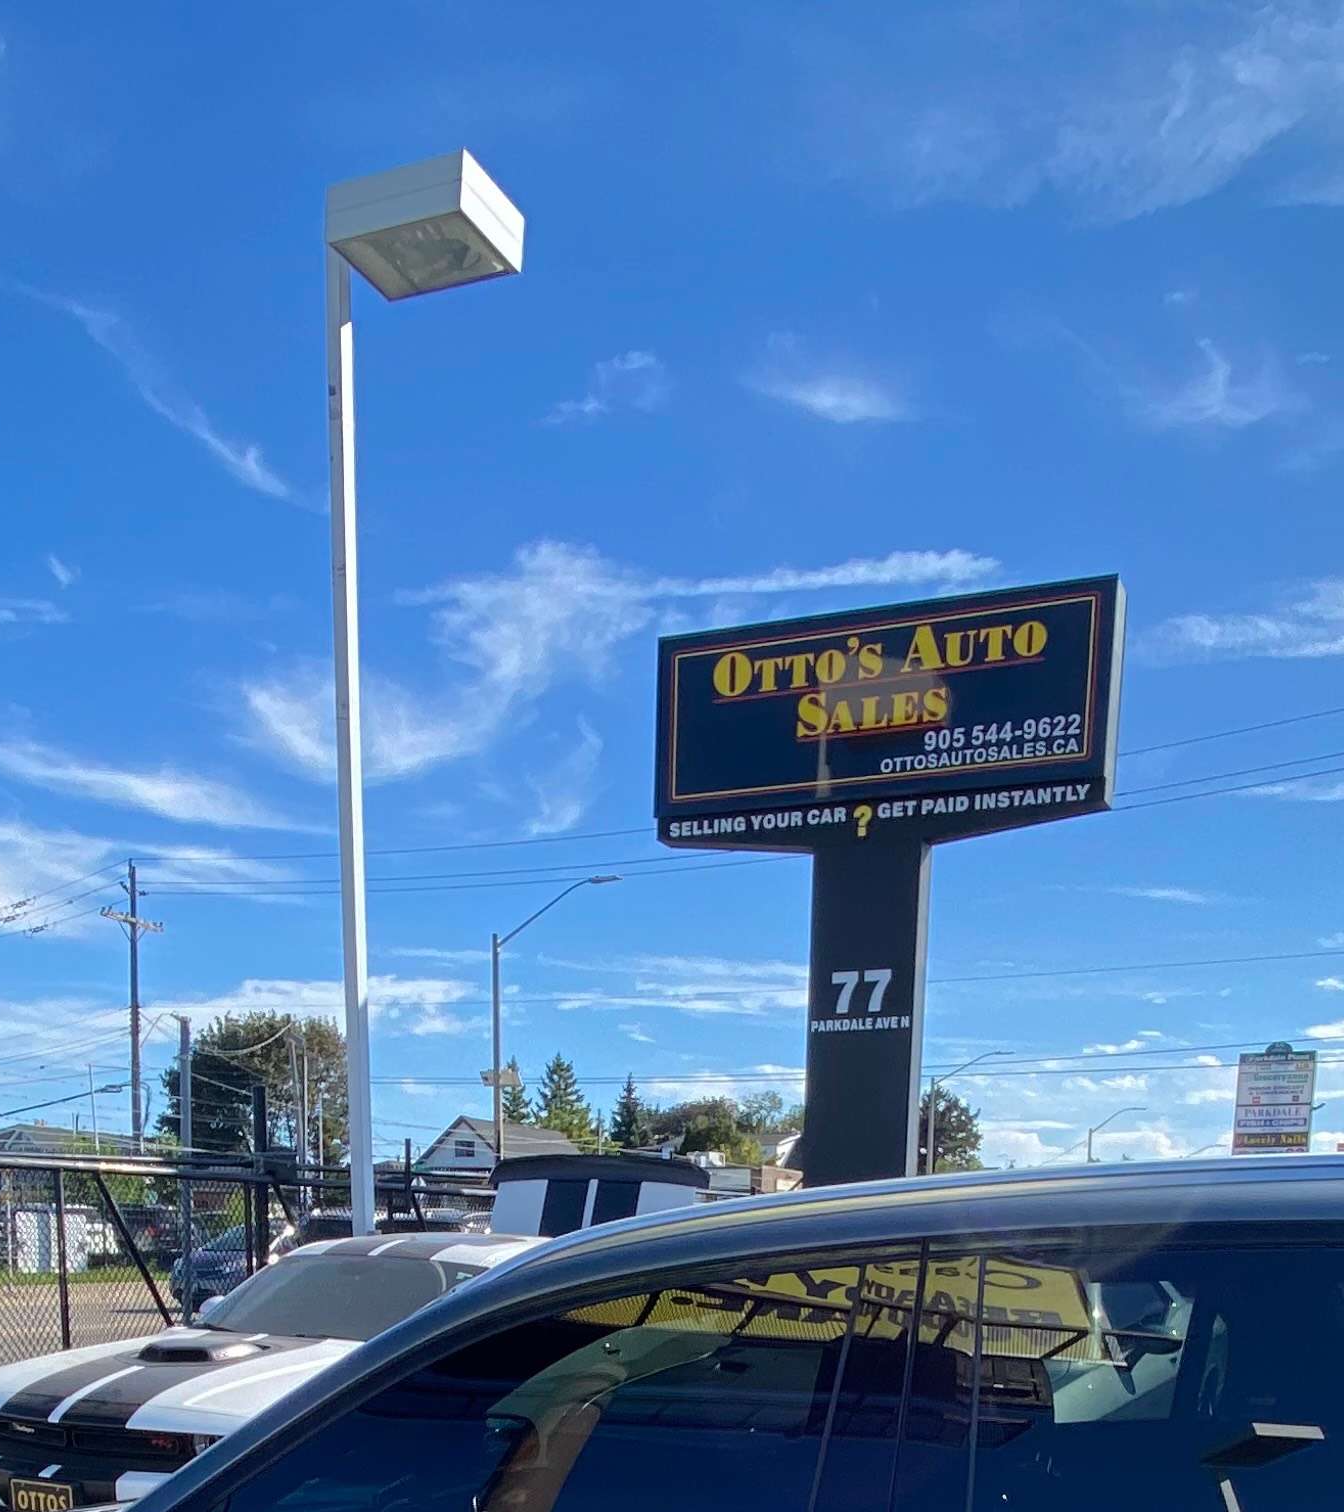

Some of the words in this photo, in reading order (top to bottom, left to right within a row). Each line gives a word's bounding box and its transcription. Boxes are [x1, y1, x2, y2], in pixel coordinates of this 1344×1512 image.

[713, 636, 883, 698] OTTO'S
[901, 621, 1048, 673] AUTO
[796, 686, 949, 738] SALES
[924, 728, 965, 752] 905
[971, 714, 1082, 745] 544-9622
[880, 739, 1080, 774] OTTOSAUTOSALES.CA
[669, 816, 747, 838] SELLING
[750, 810, 803, 831] YOUR
[807, 806, 846, 826] CAR
[877, 800, 917, 820] GET
[921, 795, 970, 816] PAID
[974, 783, 1092, 811] INSTANTLY
[831, 968, 892, 1014] 77
[810, 1017, 873, 1033] PARKDALE
[875, 1016, 899, 1030] AVE
[900, 1015, 910, 1028] N
[1244, 1107, 1301, 1118] PARKDALE
[17, 1490, 66, 1511] OTTOS
